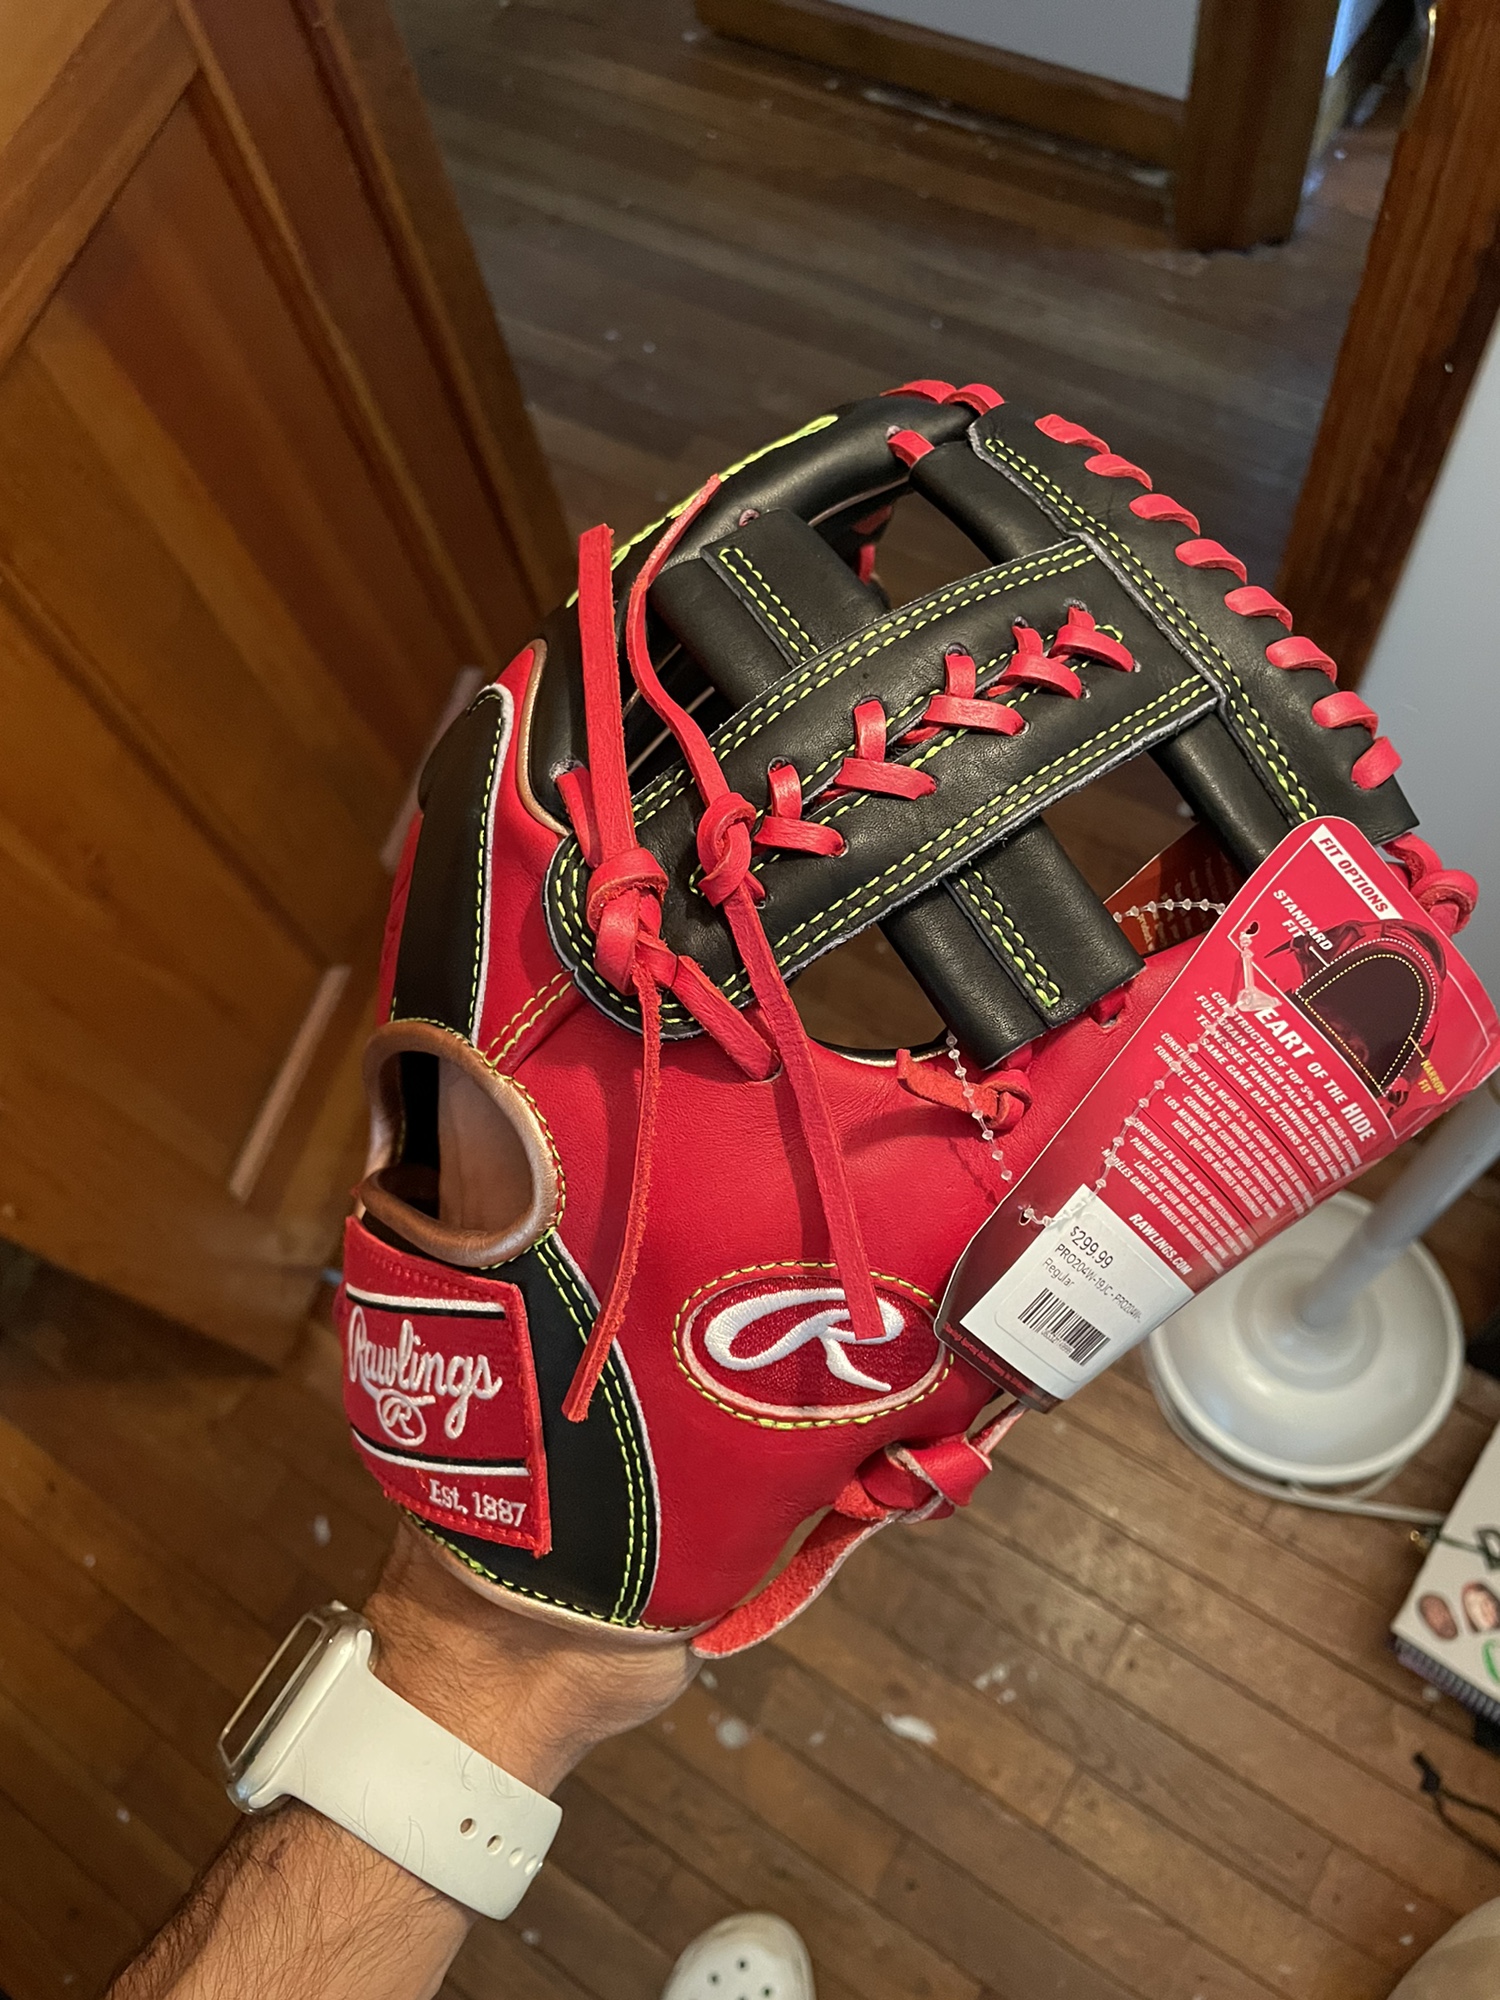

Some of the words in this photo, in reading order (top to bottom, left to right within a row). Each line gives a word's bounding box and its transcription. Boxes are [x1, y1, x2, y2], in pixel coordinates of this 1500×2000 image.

[1318, 836, 1343, 860] FIT
[1336, 857, 1389, 913] OPTIONS
[1272, 888, 1333, 951] STANDARD
[1281, 918, 1305, 939] FIT
[1195, 1014, 1247, 1065] TENESSEE
[1244, 1064, 1282, 1102] TANNING
[1278, 1101, 1312, 1137] RAWHIDE
[1199, 1038, 1228, 1065] SAME
[1225, 1063, 1253, 1090] GAME
[1250, 1089, 1270, 1109] DAY
[1265, 1106, 1302, 1145] PATTERNS
[1297, 1142, 1309, 1155] AS
[1305, 1153, 1319, 1167] TOP
[1245, 1046, 1284, 1085] LEATHER
[1280, 1083, 1305, 1108] PALM
[1301, 1106, 1318, 1124] AND
[1250, 1002, 1314, 1062] EART
[1306, 1060, 1328, 1081] OF
[1323, 1079, 1348, 1105] THE
[1340, 1101, 1376, 1142] HIDE
[1272, 1054, 1288, 1068] OF
[1284, 1067, 1304, 1086] TOP
[1300, 1084, 1316, 1101] 5%
[1312, 1099, 1330, 1117] PRO
[1325, 1115, 1347, 1140] GRADE
[1417, 1079, 1433, 1094] FIT
[1419, 1059, 1446, 1095] NARROW
[1163, 1096, 1179, 1110] LOS
[1176, 1108, 1205, 1136] MISMOS
[1201, 1133, 1227, 1158] MOLDES
[1223, 1155, 1237, 1170] QUE
[1232, 1166, 1246, 1179] LOS
[1182, 1074, 1195, 1085] LA
[1190, 1083, 1215, 1106] PALMA
[1217, 1110, 1231, 1123] DEL
[1228, 1121, 1250, 1143] DORSO
[1245, 1140, 1257, 1151] DE
[1252, 1148, 1266, 1161] LOS
[1183, 1094, 1212, 1122] CORDÓN
[1208, 1120, 1220, 1132] DE
[1217, 1130, 1238, 1150] CUERO
[1233, 1147, 1254, 1168] CRUDO
[1197, 1071, 1211, 1082] EN
[1207, 1080, 1219, 1090] EL
[1215, 1088, 1240, 1112] MEJOR
[1245, 1120, 1256, 1130] DE
[1252, 1128, 1272, 1149] CUERO
[1268, 1146, 1279, 1157] DE
[1129, 1136, 1154, 1160] PAUME
[1151, 1157, 1163, 1169] ET
[1159, 1166, 1190, 1195] DOUBLURE
[1186, 1193, 1200, 1206] DES
[1163, 1149, 1175, 1160] EN
[1171, 1158, 1189, 1174] CUIR
[1184, 1171, 1197, 1182] DE
[1171, 1119, 1192, 1140] IGUAL
[1188, 1137, 1204, 1152] QUE
[1200, 1149, 1215, 1163] LOS
[1211, 1160, 1237, 1187] MEJORES
[1129, 1175, 1150, 1195] GAME
[1146, 1192, 1161, 1206] DAY
[1133, 1160, 1159, 1184] LACETS
[1155, 1181, 1166, 1192] DE
[1162, 1189, 1179, 1205] CUIR
[1175, 1202, 1192, 1218] BRUT
[1042, 1257, 1075, 1288] Regular
[1054, 1242, 1113, 1296] PRO204W-19JC
[1070, 1225, 1114, 1270] $299.99
[1128, 1212, 1192, 1275] RAWLINGS.COM
[348, 1306, 503, 1440] Rawlings
[429, 1478, 468, 1514] Est.
[472, 1491, 527, 1527] 1887
